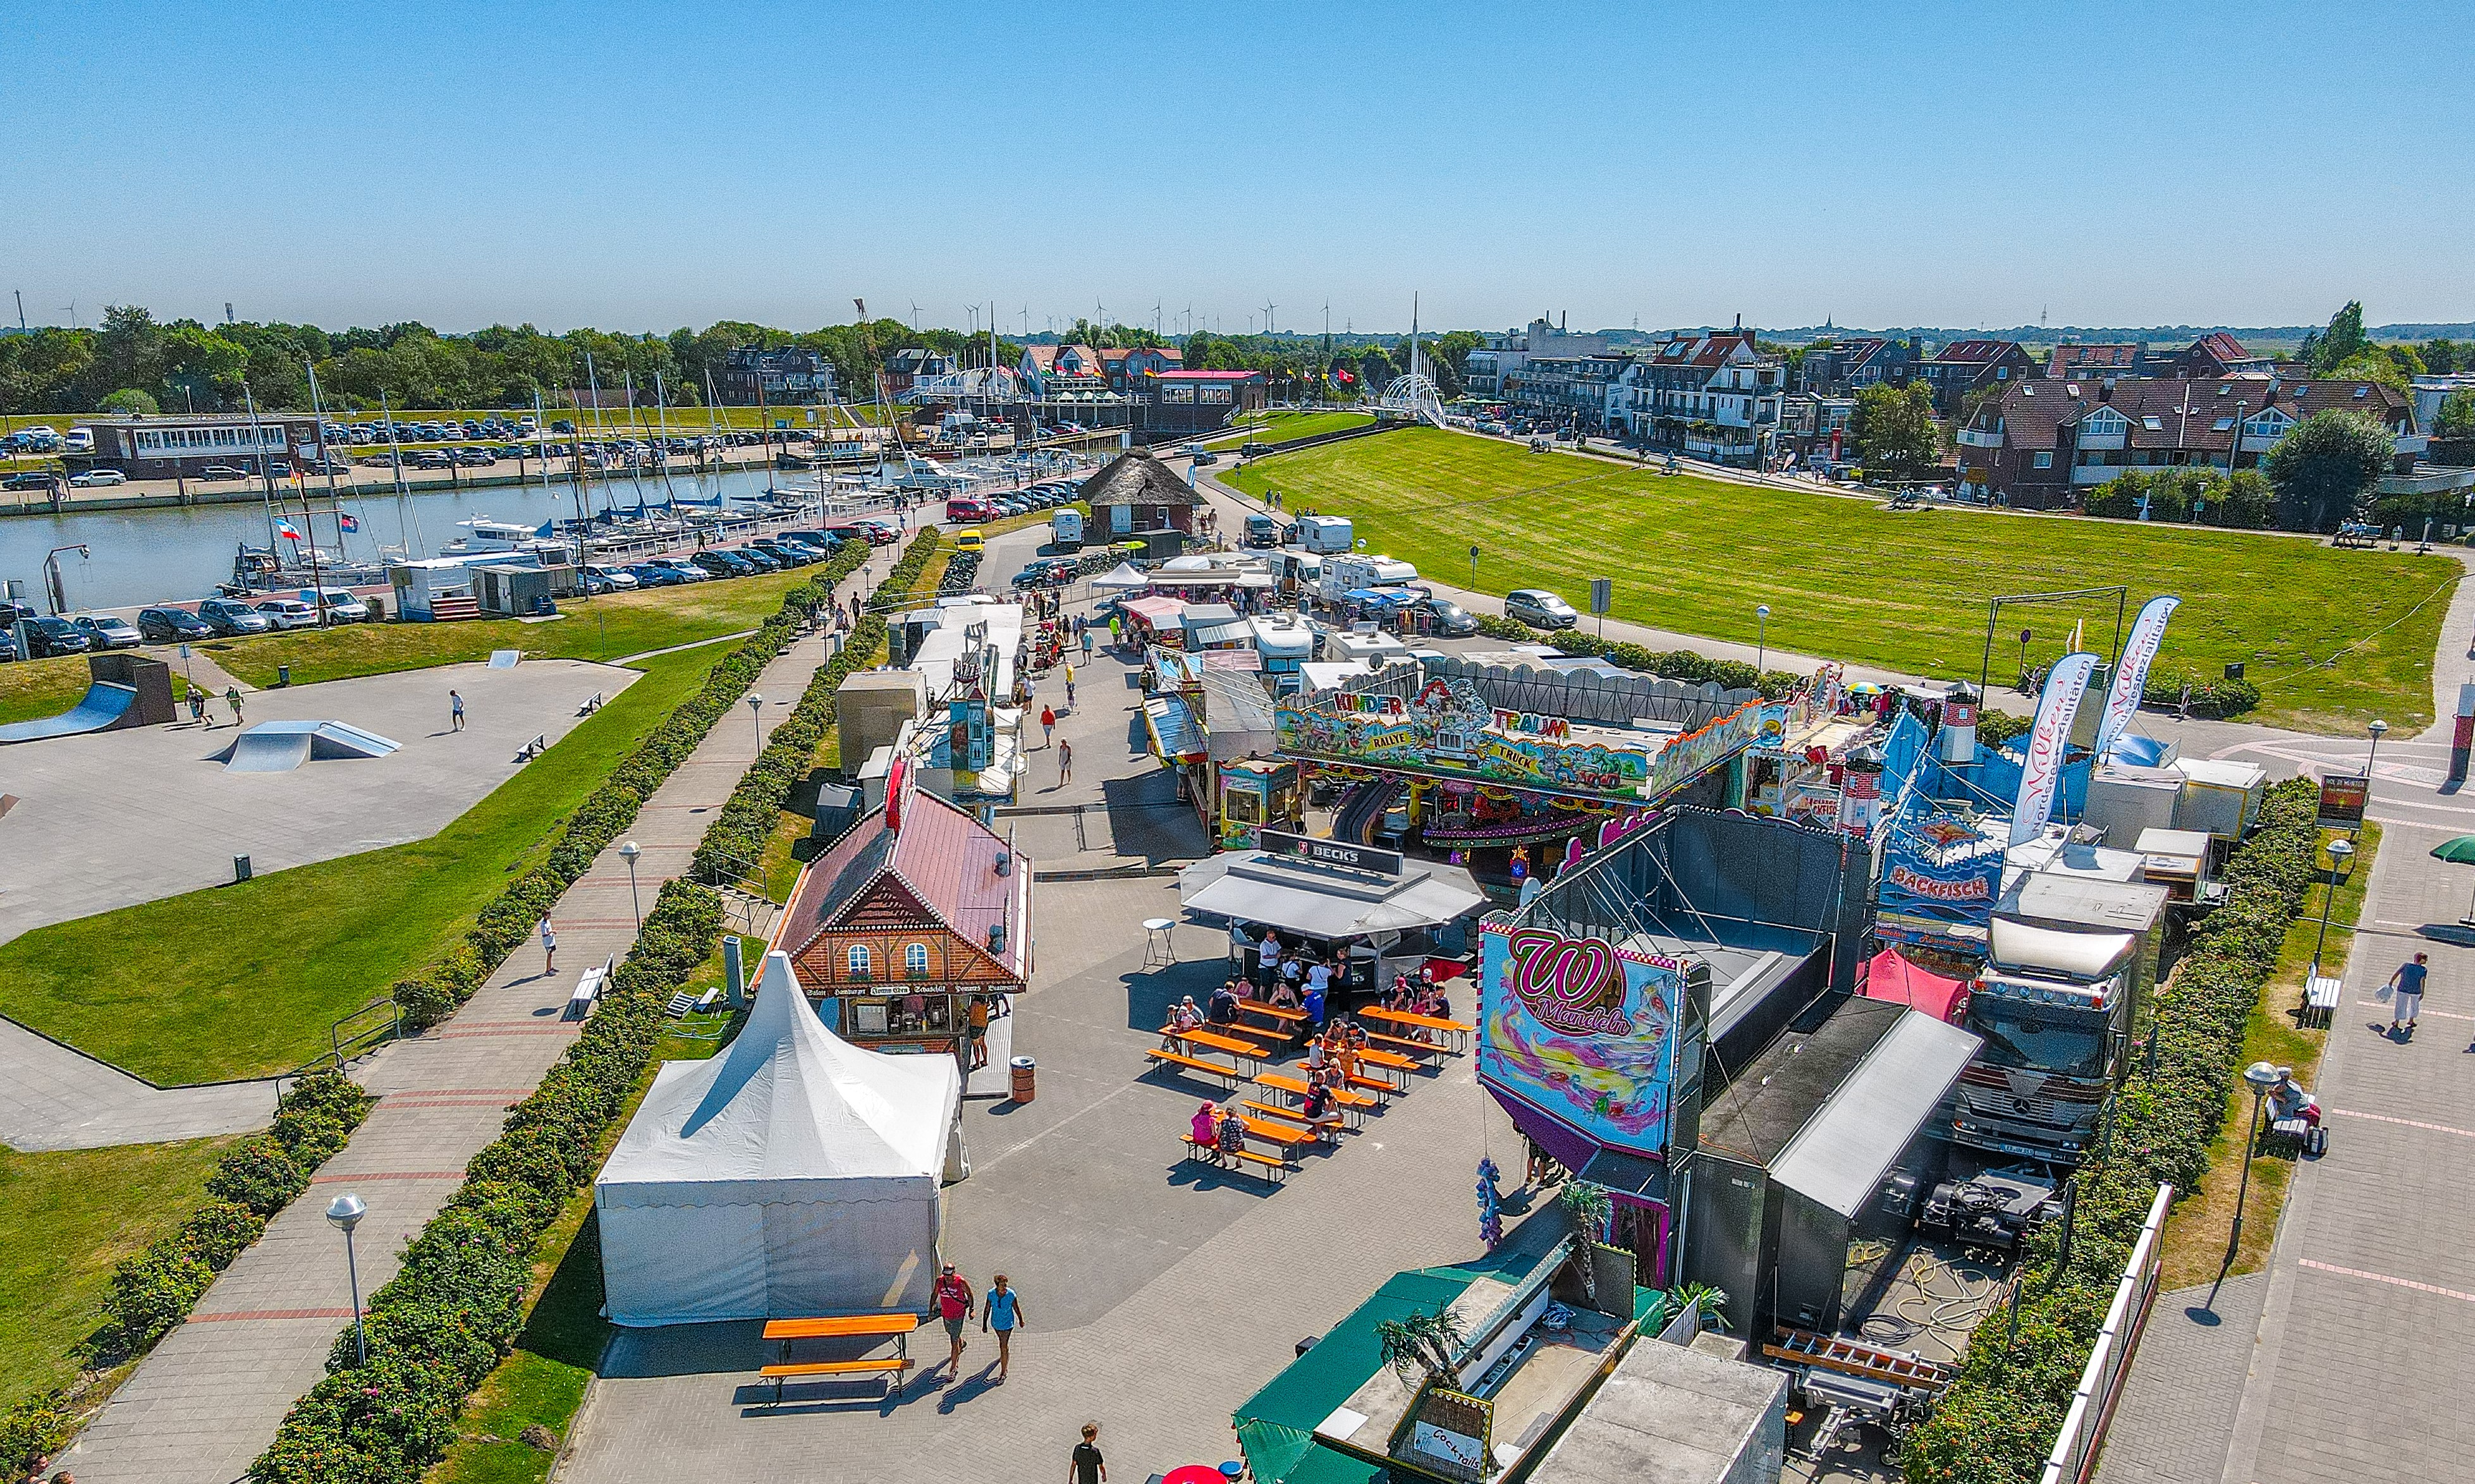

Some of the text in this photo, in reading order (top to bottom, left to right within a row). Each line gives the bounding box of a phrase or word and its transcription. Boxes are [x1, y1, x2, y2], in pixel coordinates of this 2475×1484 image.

[1333, 692, 1570, 739] KINDER TRAUM
[1373, 733, 1531, 769] RALLYE TRUCK
[1313, 846, 1359, 863] BECK'S
[1895, 868, 1984, 897] BACKFISCH
[1512, 931, 1609, 1004] W
[1536, 997, 1631, 1037] Mandeln
[1433, 1429, 1480, 1468] Cocktails
